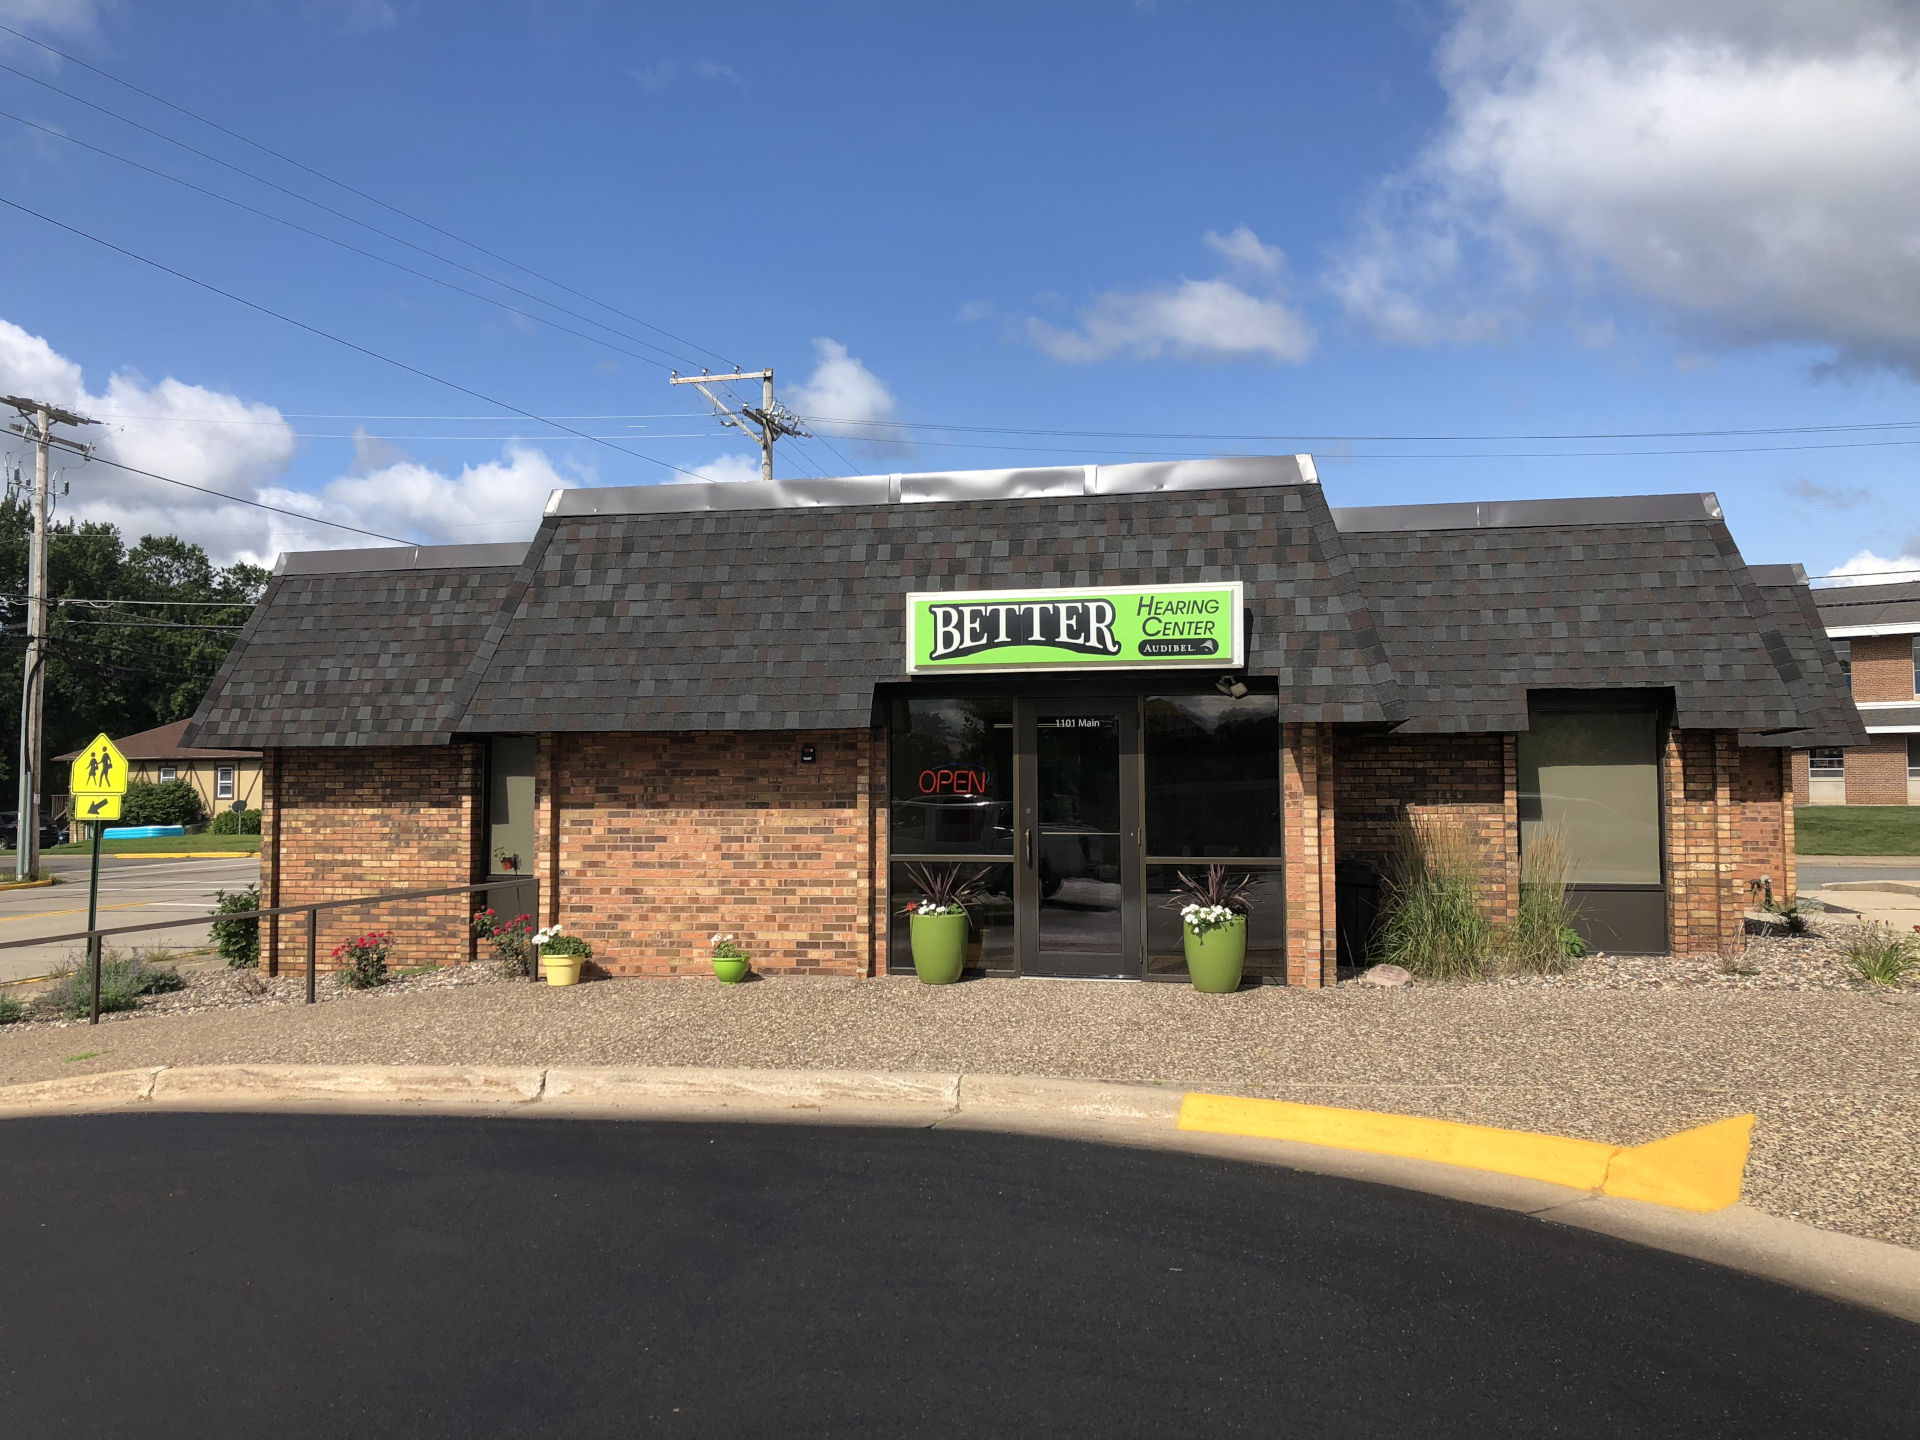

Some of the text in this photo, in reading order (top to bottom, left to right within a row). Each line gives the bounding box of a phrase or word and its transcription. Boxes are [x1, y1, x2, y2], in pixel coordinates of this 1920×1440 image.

[1137, 595, 1220, 616] HEARING
[931, 601, 1120, 658] BETTER
[1142, 616, 1216, 637] CENTER
[1143, 644, 1194, 653] AUDIBEL
[1055, 718, 1100, 728] 1101 Main
[919, 769, 986, 793] OPEN
